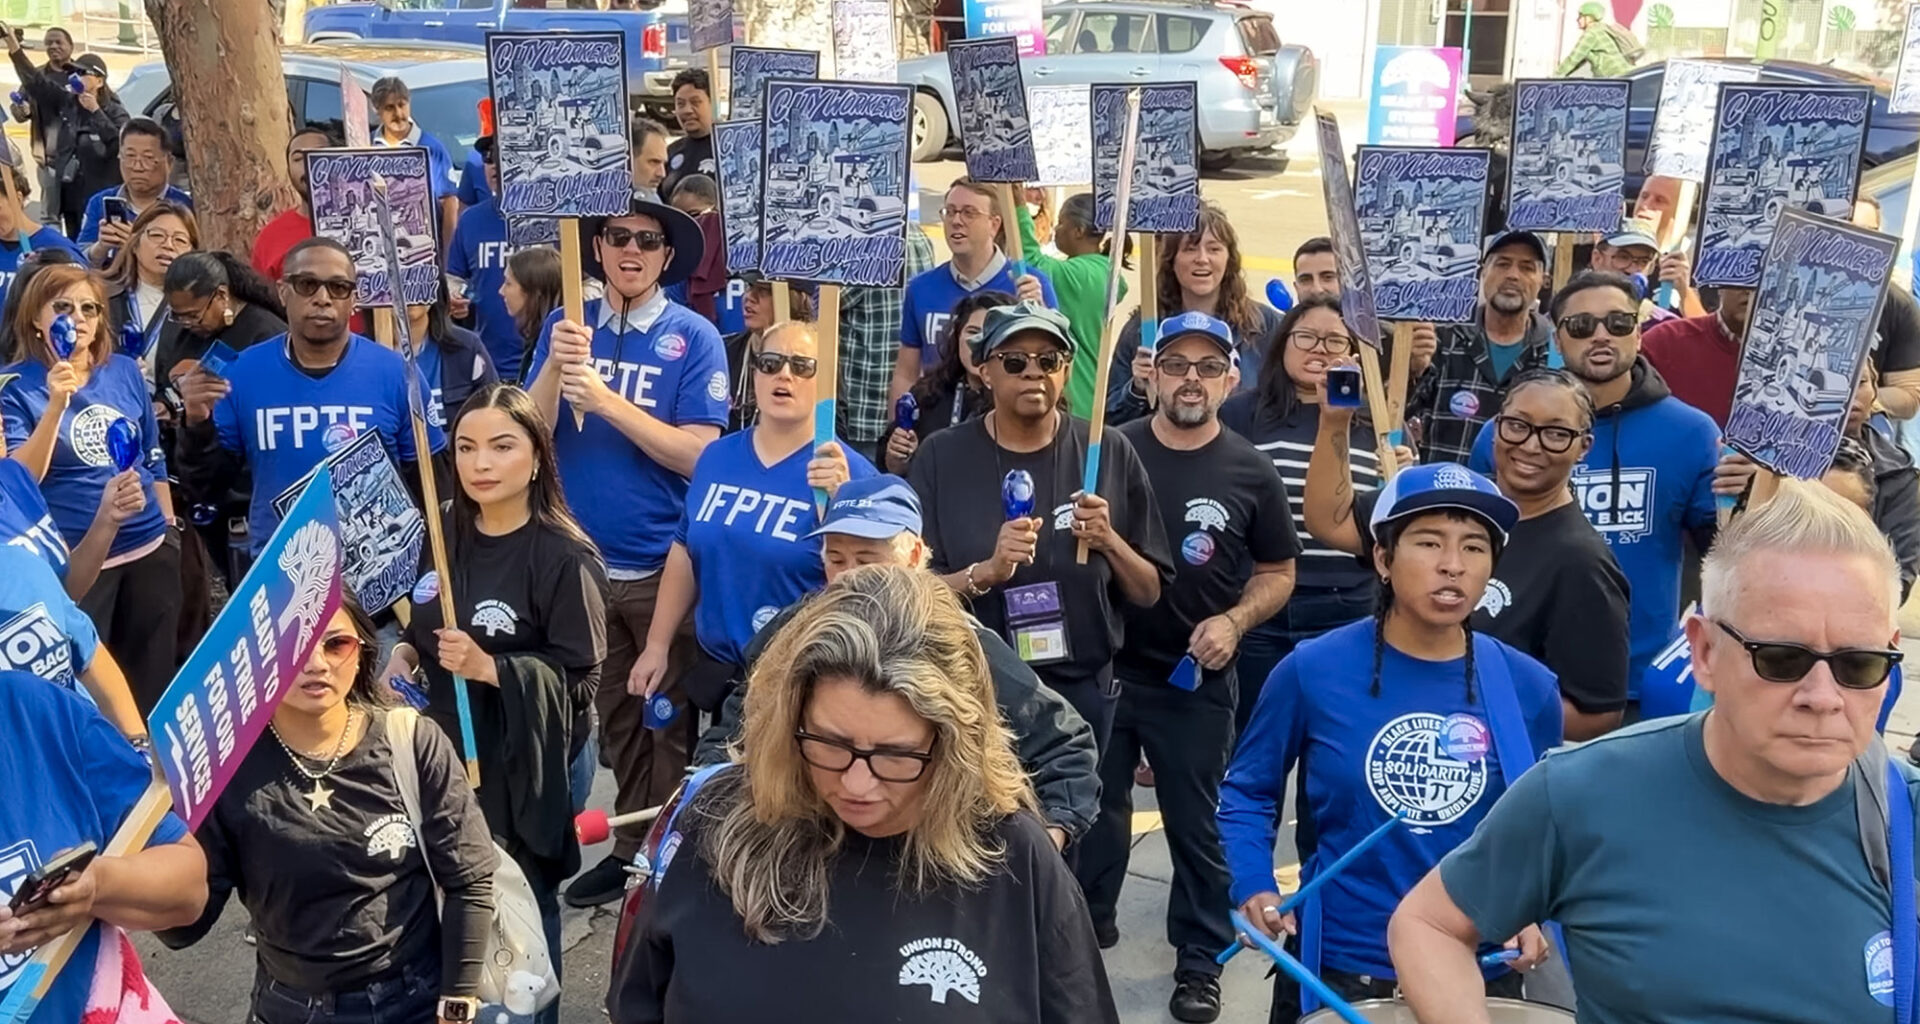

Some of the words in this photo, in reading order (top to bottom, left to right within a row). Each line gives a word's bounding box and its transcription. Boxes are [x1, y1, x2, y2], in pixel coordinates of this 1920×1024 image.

[493, 39, 544, 74] CITY
[541, 39, 620, 66] WORKERS
[769, 87, 824, 123] CITY
[821, 89, 908, 121] WORKERS
[1095, 89, 1128, 117] CIT
[1141, 89, 1194, 109] ORKERS
[1520, 83, 1562, 112] CITY
[1722, 91, 1785, 128] CITY
[1780, 92, 1866, 122] WORKERS
[312, 156, 359, 186] CITY
[355, 156, 425, 178] WORKERS
[556, 169, 632, 199] OAKLAND
[1361, 152, 1411, 184] CITY
[1409, 153, 1487, 178] WORKERS
[501, 181, 558, 214] MAKE
[575, 189, 632, 217] RUN!
[763, 243, 821, 279] MAKE
[841, 257, 904, 286] RUN!
[821, 235, 906, 266] OAKLAND
[1693, 248, 1762, 286] MAKE
[1771, 221, 1818, 264] CITY
[1811, 231, 1891, 282] WORKERS
[1372, 285, 1401, 315] KE
[1418, 298, 1476, 322] RUN!
[1401, 277, 1478, 307] OAKLAND
[1763, 411, 1840, 457] OAKLAND
[1775, 443, 1831, 481] RUN!
[696, 482, 811, 543] IFPTE
[1577, 483, 1646, 511] ION
[249, 584, 277, 669] READY
[264, 661, 280, 703] TO
[203, 661, 230, 723] FOR
[230, 636, 257, 726] STRIKE
[176, 693, 213, 805] SERVICES
[216, 710, 235, 767] OUR
[1381, 719, 1412, 747] BLACK
[1411, 719, 1443, 731] LIVES
[1371, 760, 1385, 786] STOP
[1378, 785, 1399, 810] AAPI
[1384, 760, 1471, 782] SOLIDARITY
[1437, 799, 1468, 820] UNION
[1467, 771, 1482, 801] PRIDE
[899, 937, 942, 957] UNION
